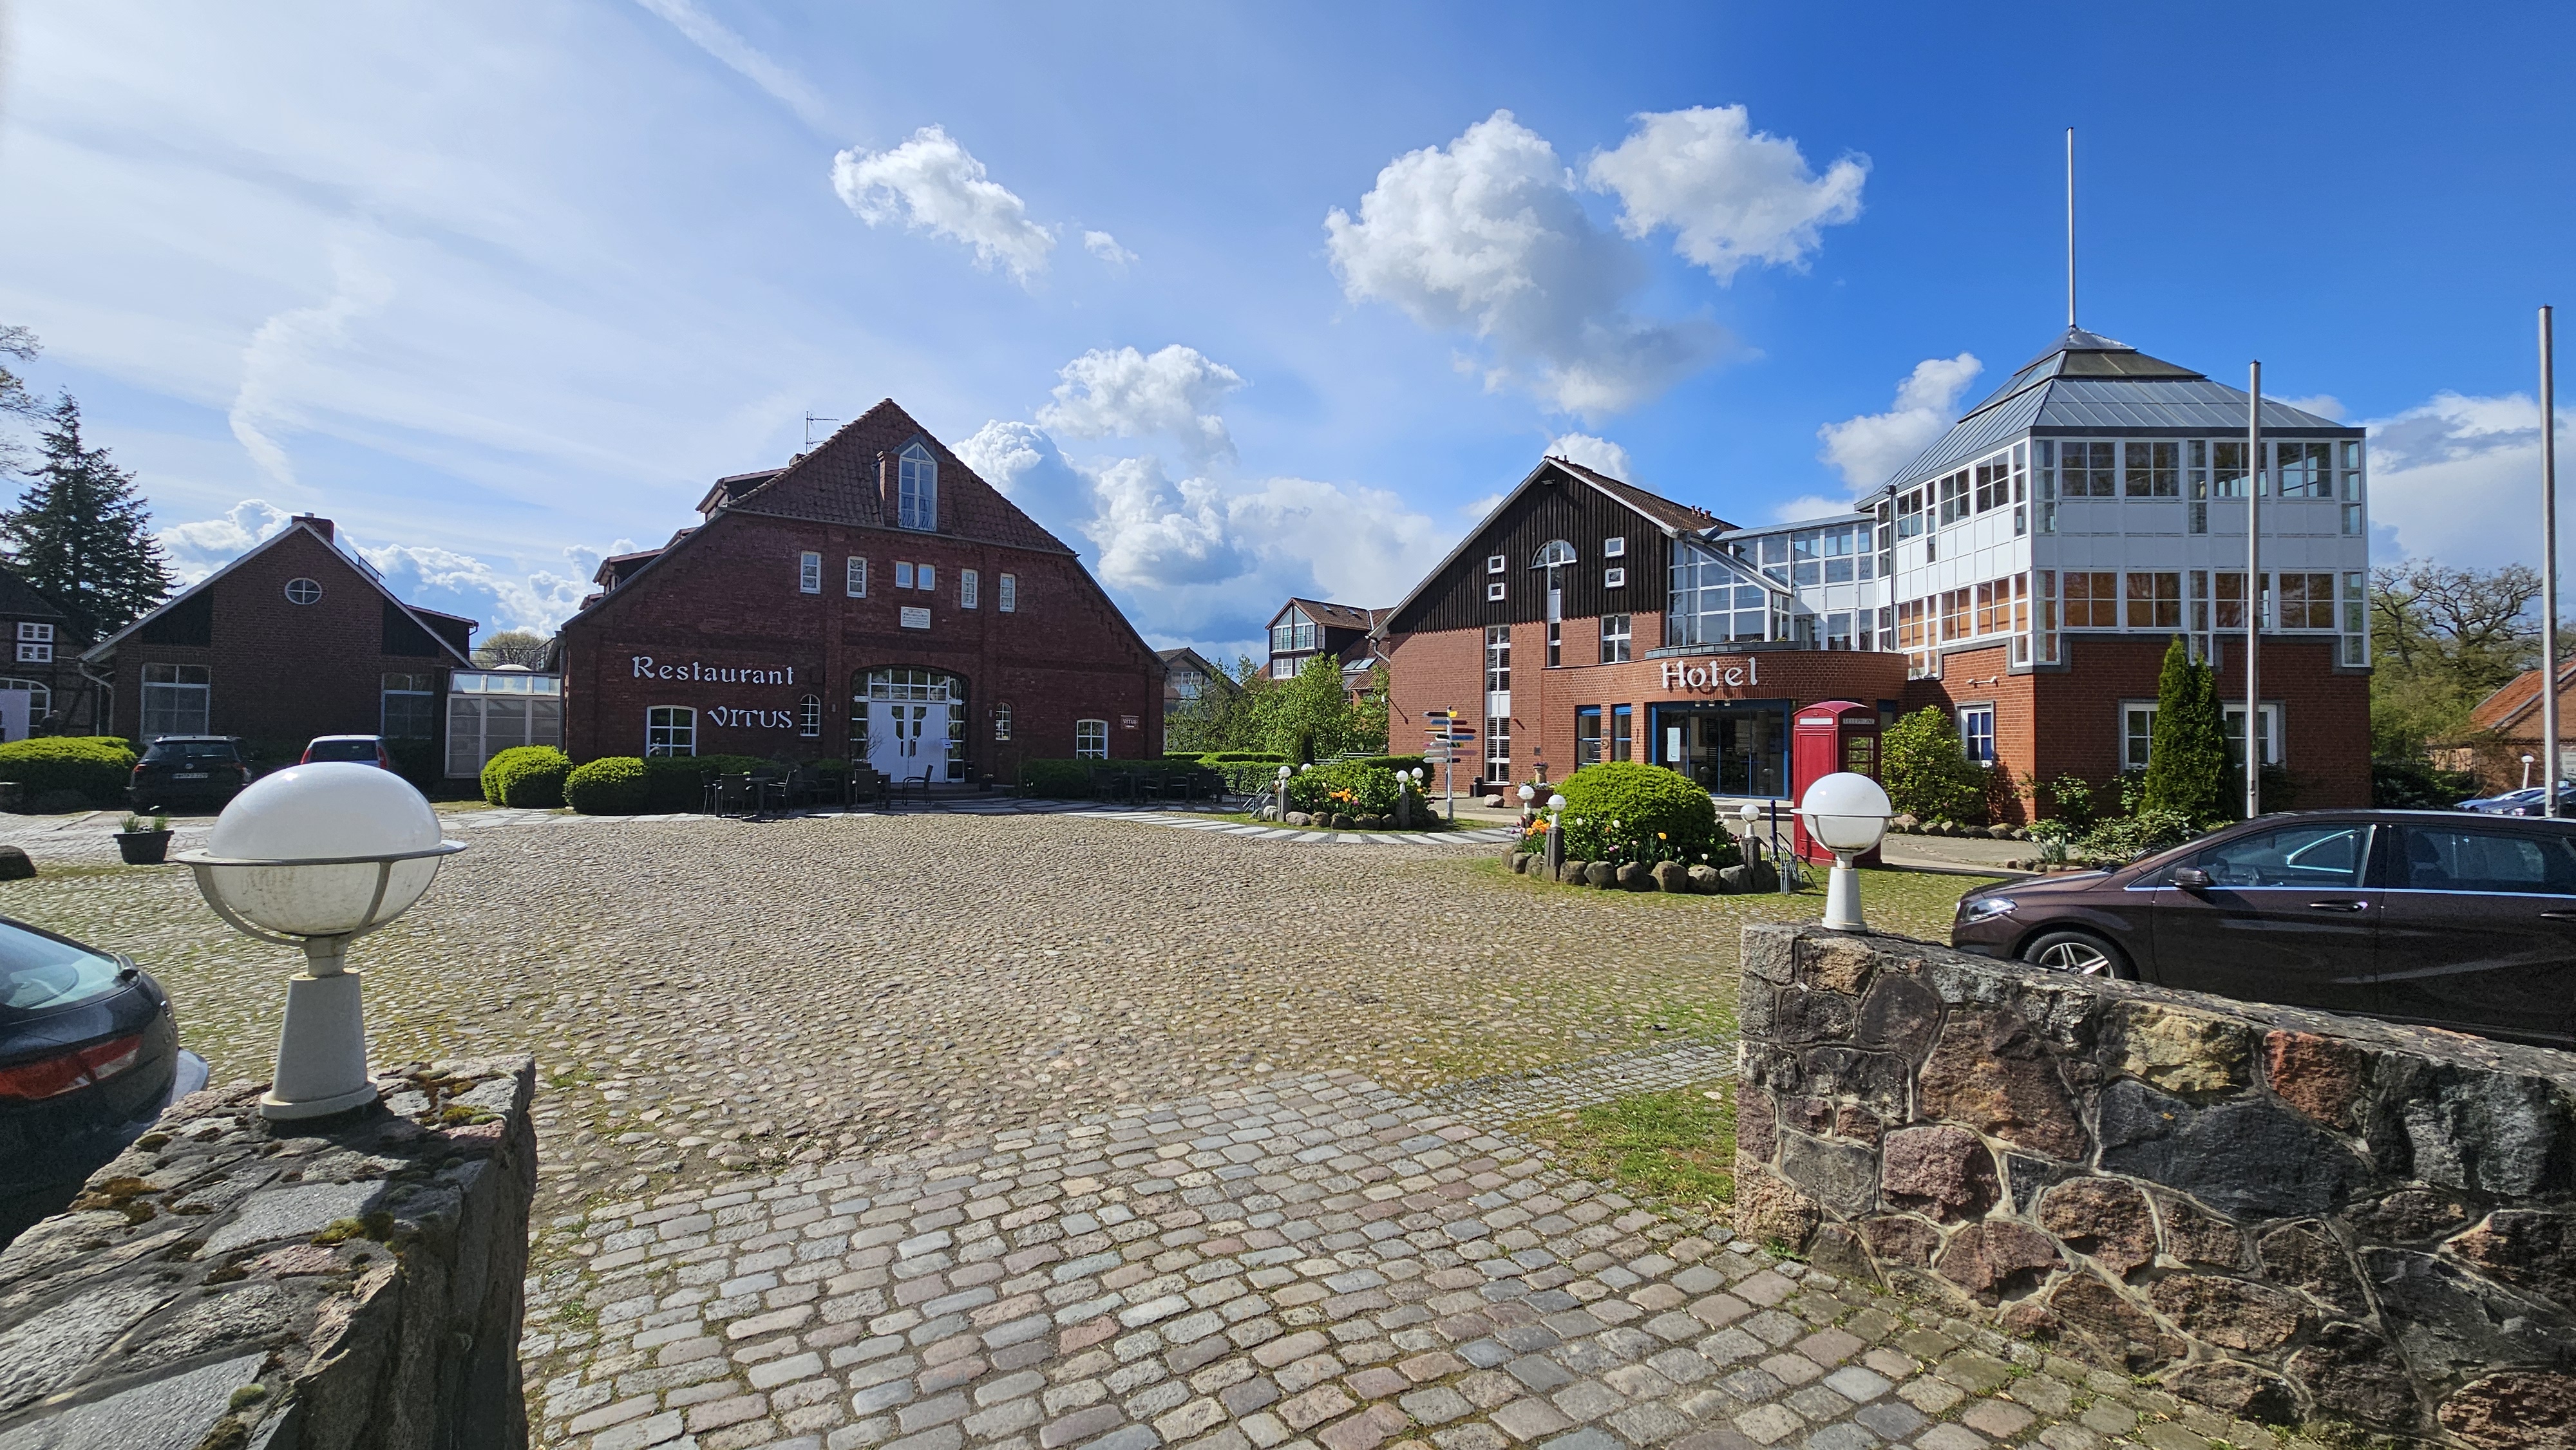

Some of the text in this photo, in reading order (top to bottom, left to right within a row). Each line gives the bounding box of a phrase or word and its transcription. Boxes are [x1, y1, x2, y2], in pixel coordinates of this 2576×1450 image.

[632, 656, 794, 685] Restaurant
[1660, 657, 1758, 689] Hotel
[707, 706, 793, 728] VITUS
